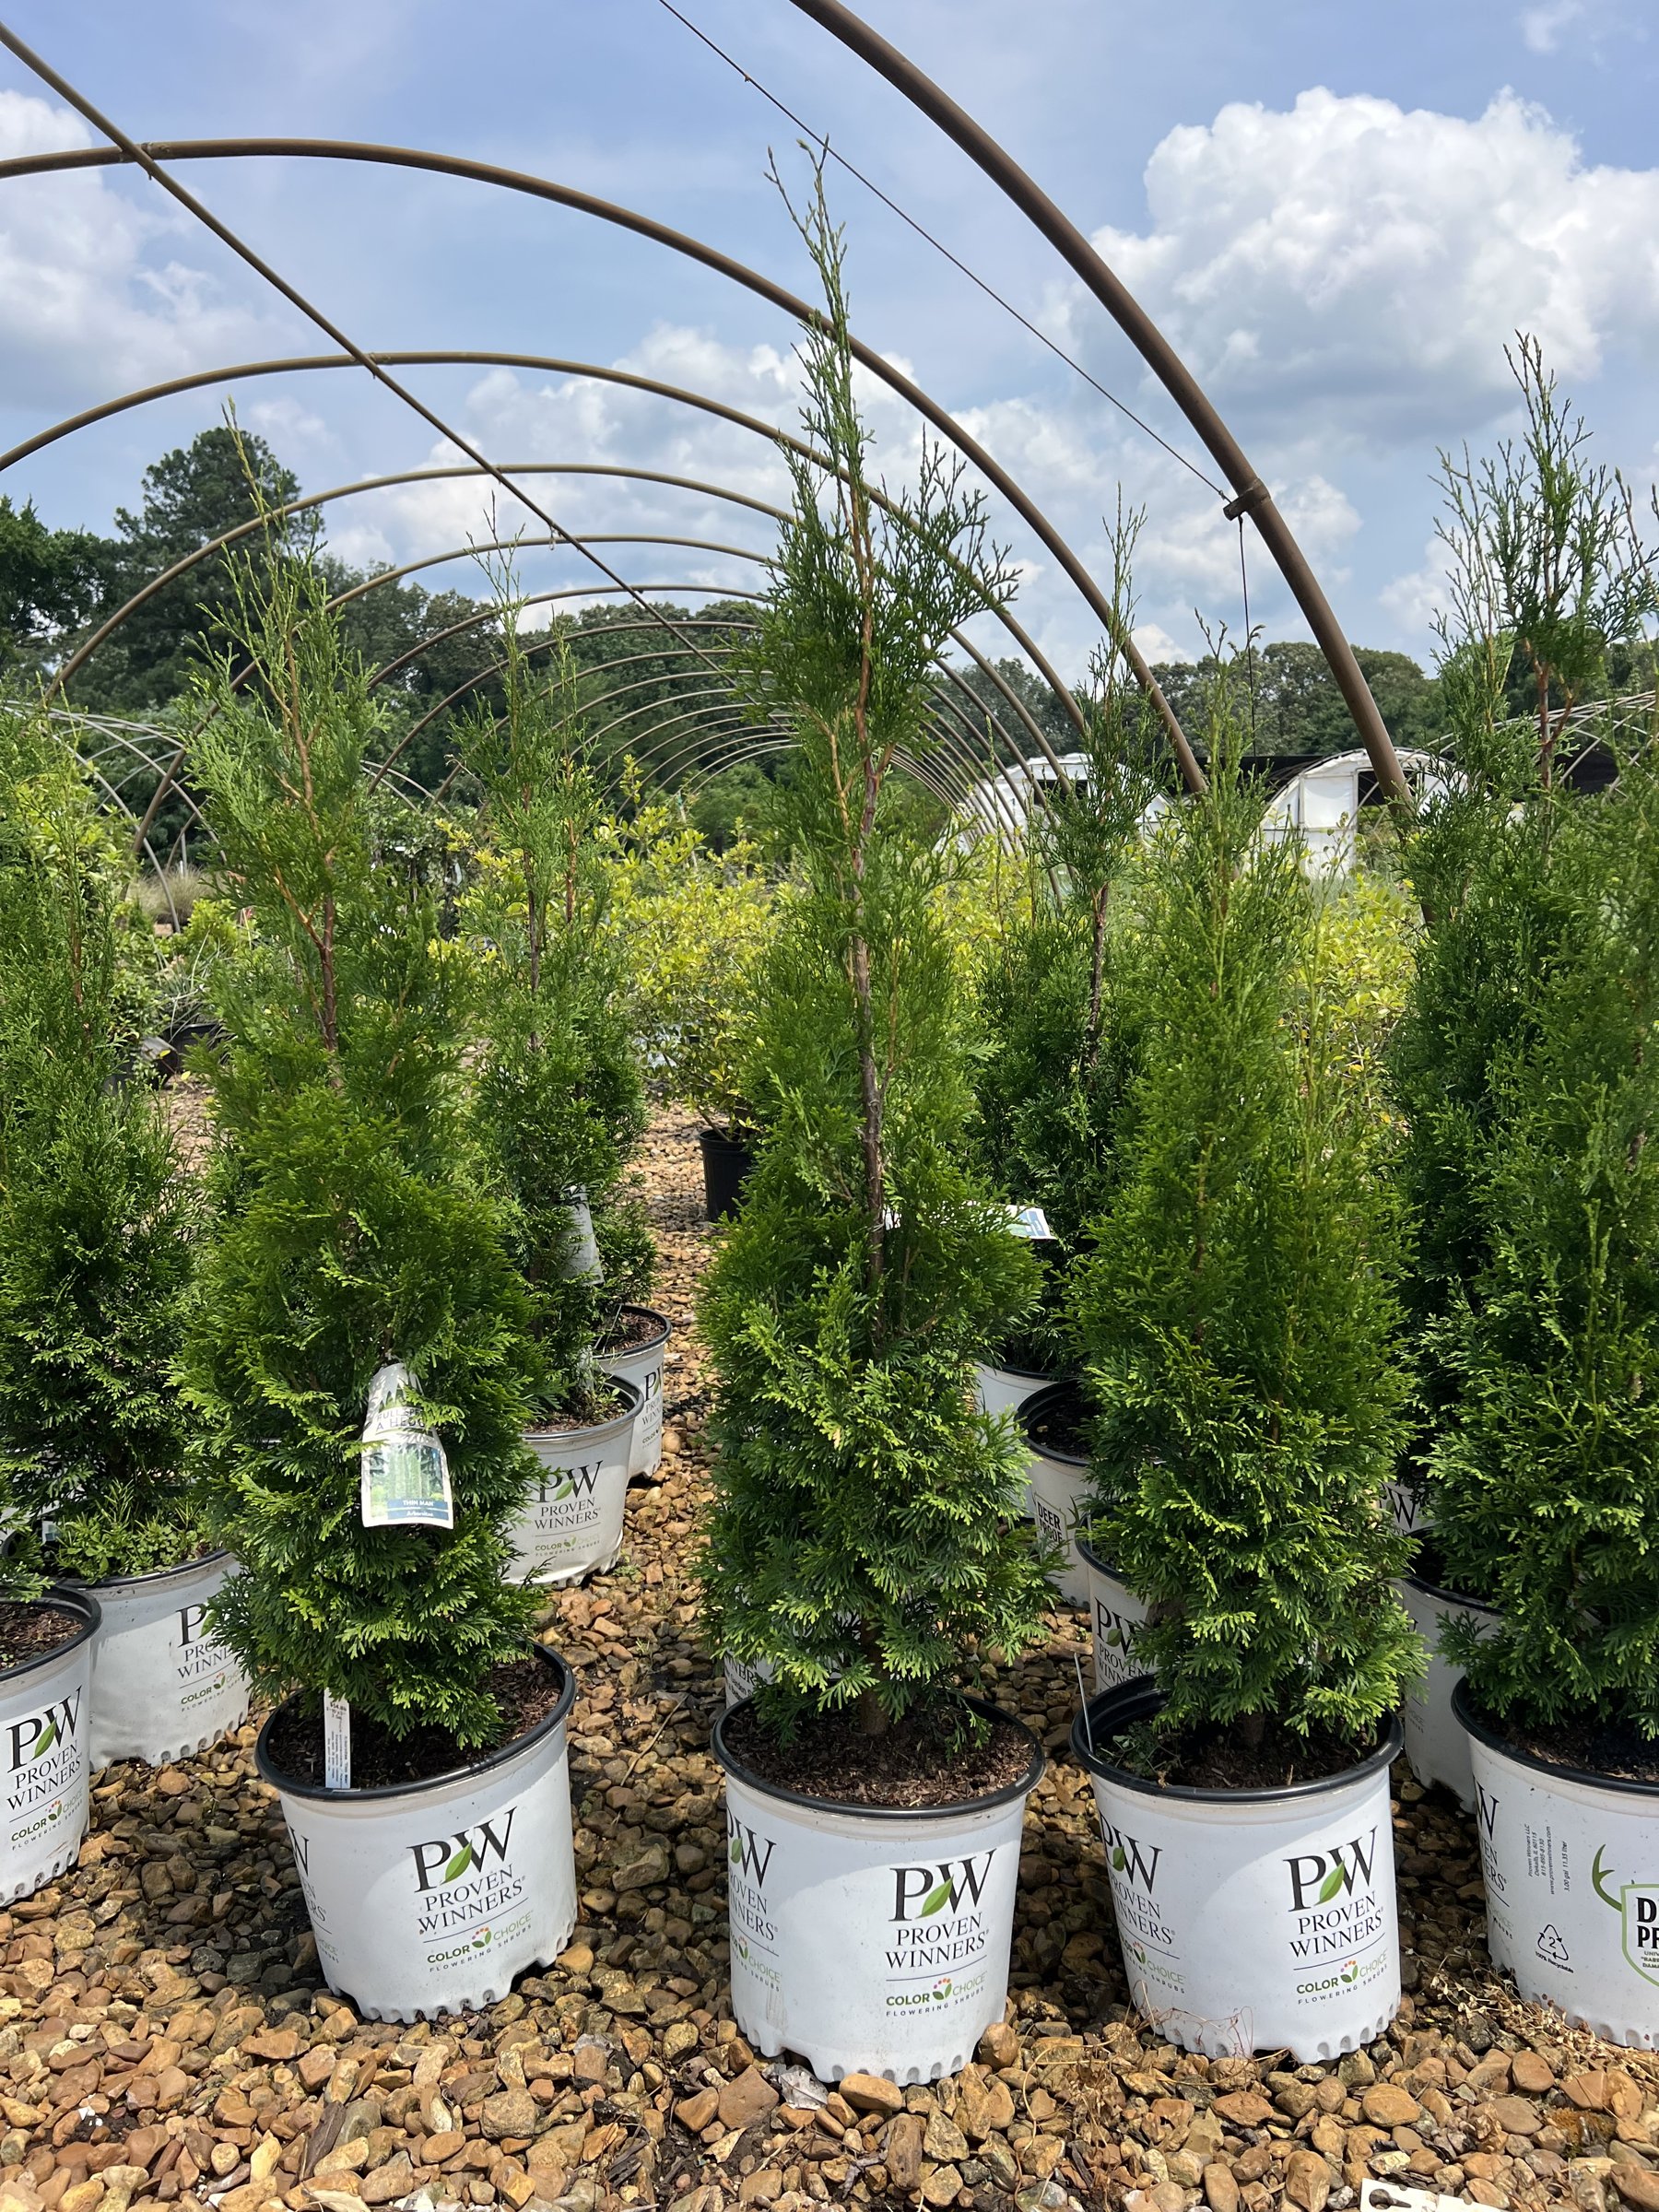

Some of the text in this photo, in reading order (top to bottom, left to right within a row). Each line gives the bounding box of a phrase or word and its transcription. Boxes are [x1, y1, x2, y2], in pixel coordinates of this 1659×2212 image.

[541, 1497, 596, 1517] PROVEN
[1037, 1501, 1062, 1531] DEER
[535, 1542, 562, 1551] COLOR
[181, 1687, 213, 1705] COLOR
[6, 1685, 82, 1773] PW
[15, 1739, 78, 1790] PROVEN
[11, 1789, 83, 1841] COLOR CHOICE
[12, 1821, 62, 1851] FLOWERING
[406, 1806, 517, 1893] PW
[888, 1848, 997, 1922] PW
[1282, 1825, 1378, 1912] PW
[417, 1878, 523, 1933] WINNERS
[424, 1863, 513, 1912] PROVEN
[896, 1912, 982, 1947] PROVEN
[1298, 1891, 1376, 1935] PROVEN
[427, 1912, 532, 1964] COLOR CHOICE
[429, 1924, 532, 1972] FLOWERING SHRUBS
[885, 1932, 985, 1969] WINNERS
[1289, 1909, 1382, 1958] WINNERS
[1548, 1936, 1557, 1949] 2
[749, 1956, 781, 1983] CHOICE
[1147, 1960, 1185, 1984] CHOICE
[1297, 1950, 1387, 1994] COLOR CHOICE
[1547, 1958, 1574, 1973] Recyclable
[887, 1972, 987, 2006] COLOR CHOICE
[887, 1986, 984, 2017] FLOWERING SHRUBS
[1299, 1985, 1358, 2005] FLOWERING
